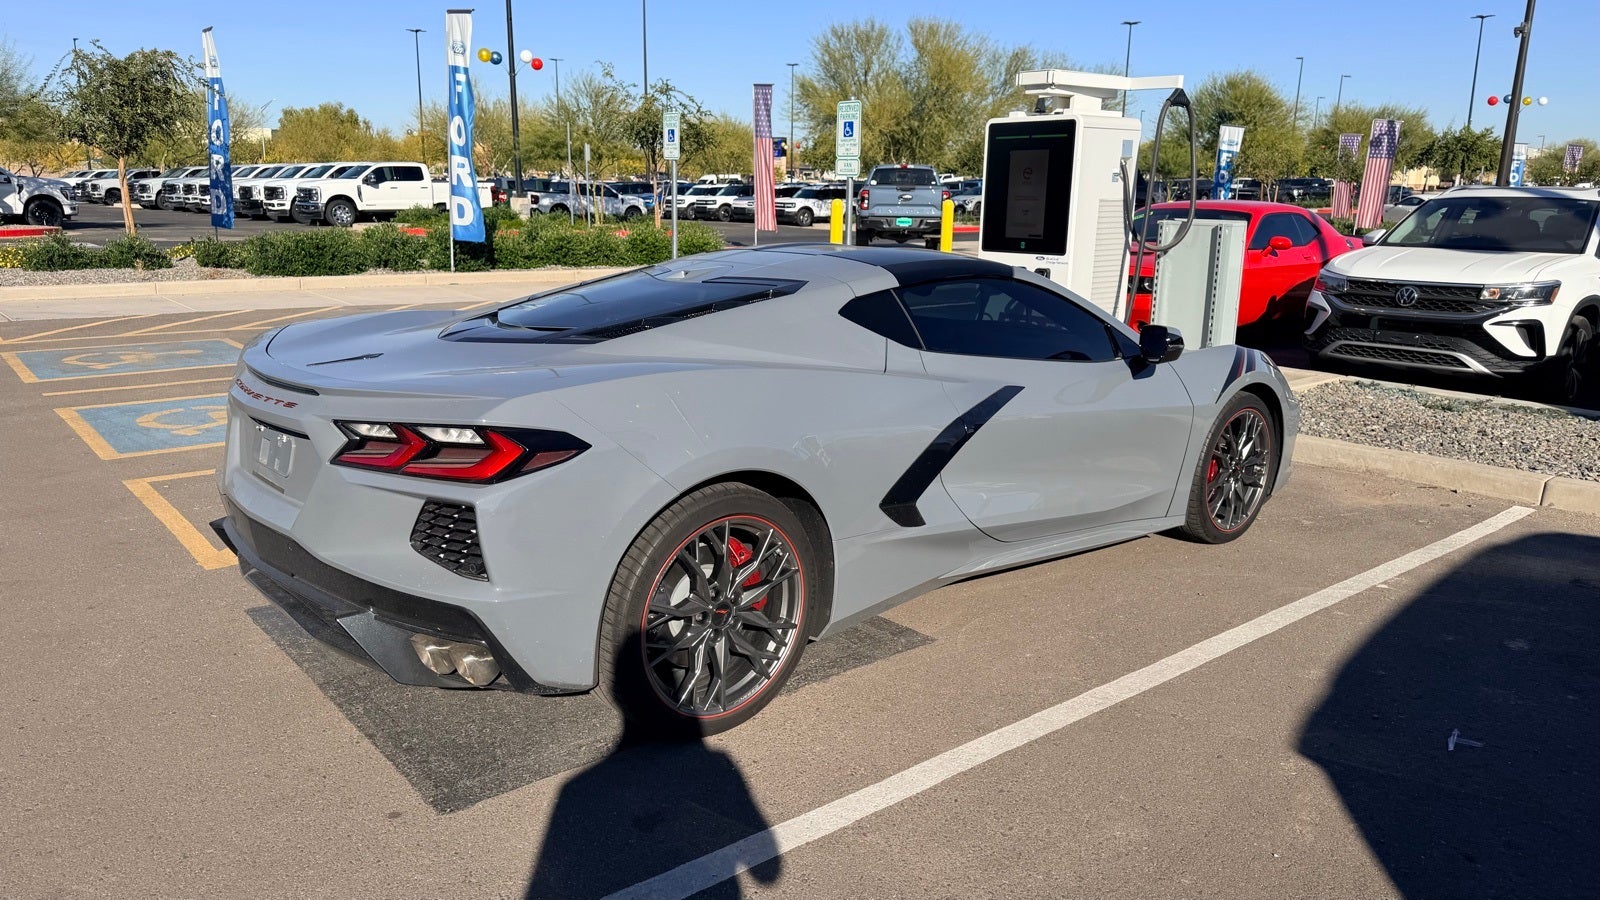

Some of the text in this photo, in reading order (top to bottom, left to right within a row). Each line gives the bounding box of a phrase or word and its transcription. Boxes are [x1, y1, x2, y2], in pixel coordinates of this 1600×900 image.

[450, 73, 474, 227] FORD
[1217, 152, 1233, 200] FOR
[235, 379, 298, 409] CORVETTE
